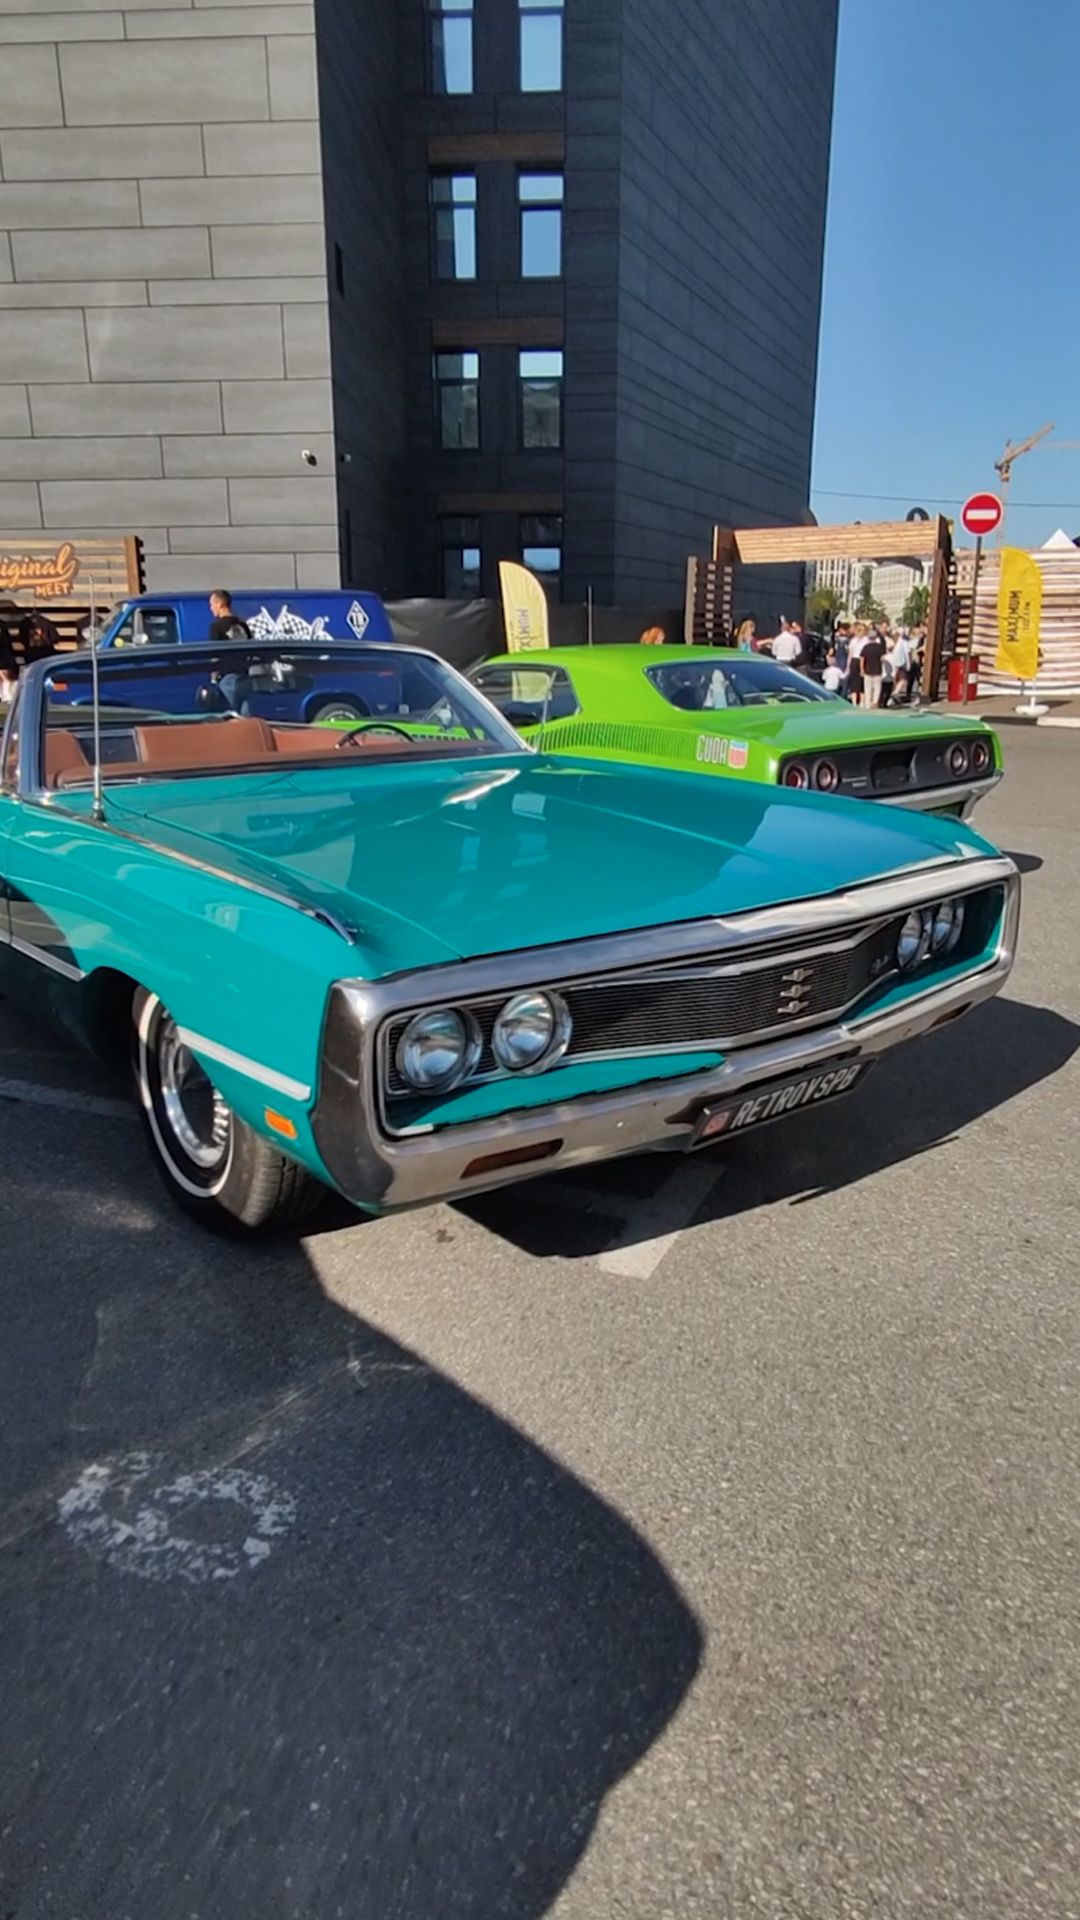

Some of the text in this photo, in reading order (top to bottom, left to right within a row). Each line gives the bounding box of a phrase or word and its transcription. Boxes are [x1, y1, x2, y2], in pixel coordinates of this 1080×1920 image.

[0, 544, 76, 588] iginal
[36, 582, 70, 596] MEET
[1005, 590, 1022, 642] MAXIMUM
[696, 735, 729, 765] CUDA
